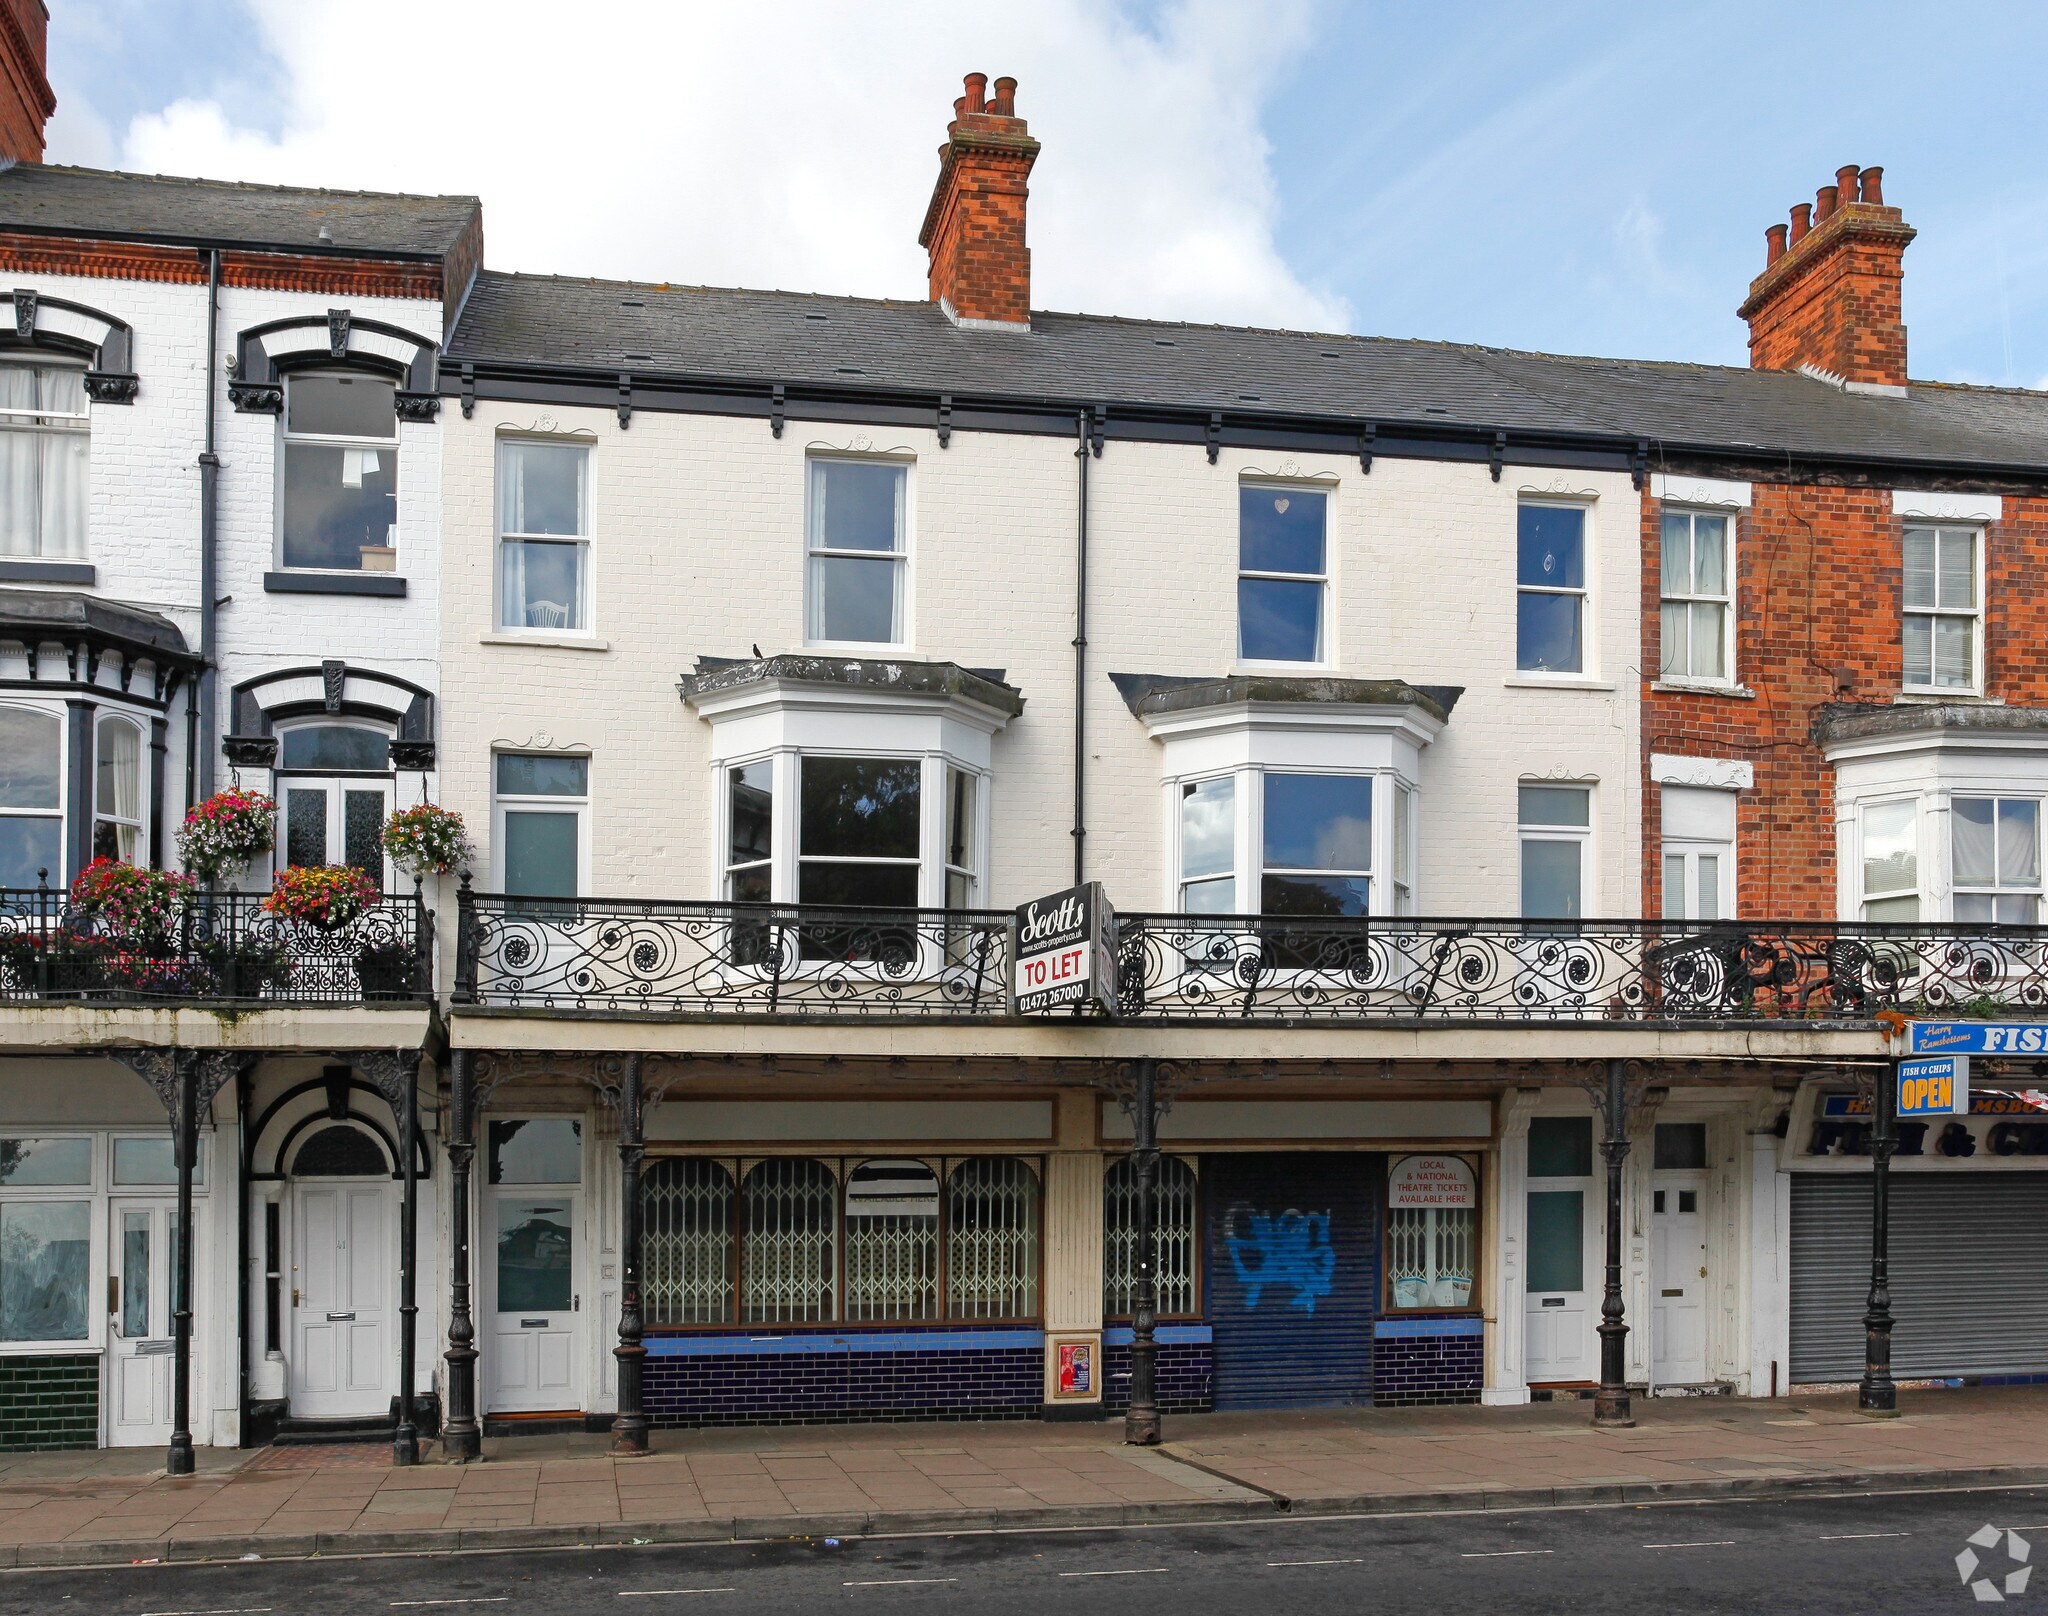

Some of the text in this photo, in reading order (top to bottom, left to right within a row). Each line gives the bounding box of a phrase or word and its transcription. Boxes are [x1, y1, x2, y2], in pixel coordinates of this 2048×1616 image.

[1021, 896, 1084, 943] Scotts
[1022, 929, 1083, 954] www.scotts-property.co.uk
[1025, 960, 1047, 987] TO
[1052, 950, 1083, 981] LET
[1020, 983, 1084, 1011] 01472 267000
[1924, 1025, 1953, 1037] Harry
[1982, 1027, 2048, 1052] FIS
[1919, 1034, 1971, 1052] Ramsbottoms
[1902, 1064, 1952, 1077] FISH & CHIPS
[1902, 1077, 1952, 1110] OPEN
[1420, 1161, 1445, 1169] LOCAL
[1407, 1172, 1458, 1180] & NATIONAL
[1399, 1195, 1466, 1203] AVAILABLE HERE
